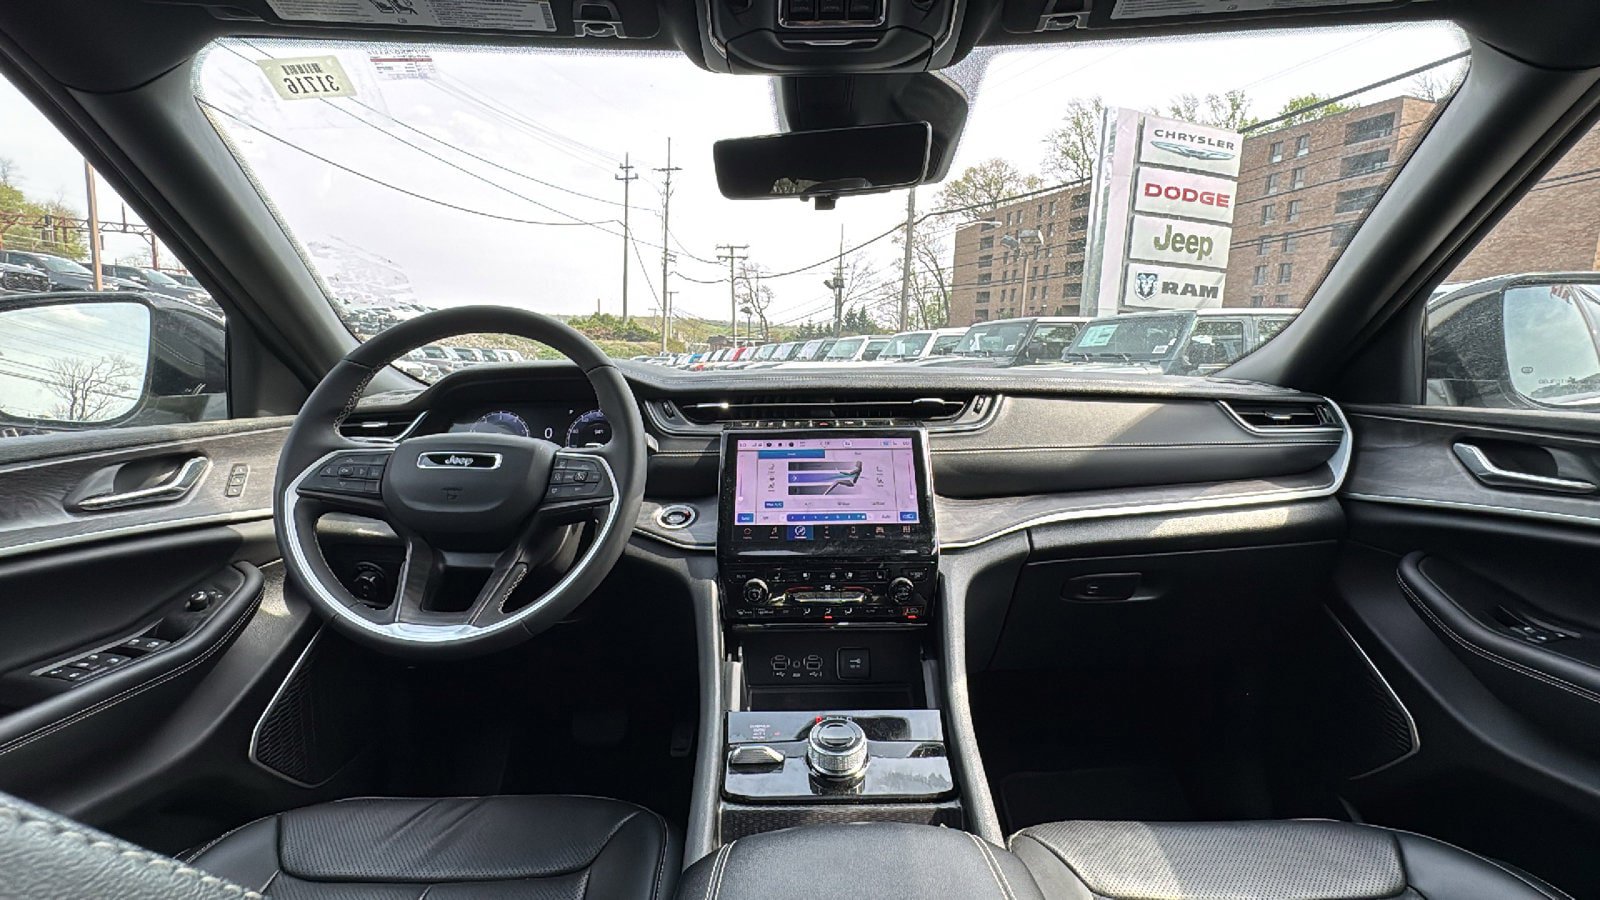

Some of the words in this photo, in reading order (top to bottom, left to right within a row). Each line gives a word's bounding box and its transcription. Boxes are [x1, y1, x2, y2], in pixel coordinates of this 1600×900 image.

[1154, 129, 1235, 151] CHRYSLER
[1144, 182, 1231, 208] DODGE
[1153, 224, 1213, 261] Jeep
[1161, 279, 1219, 299] RAM
[544, 427, 553, 439] 0
[444, 454, 474, 467] Jeep
